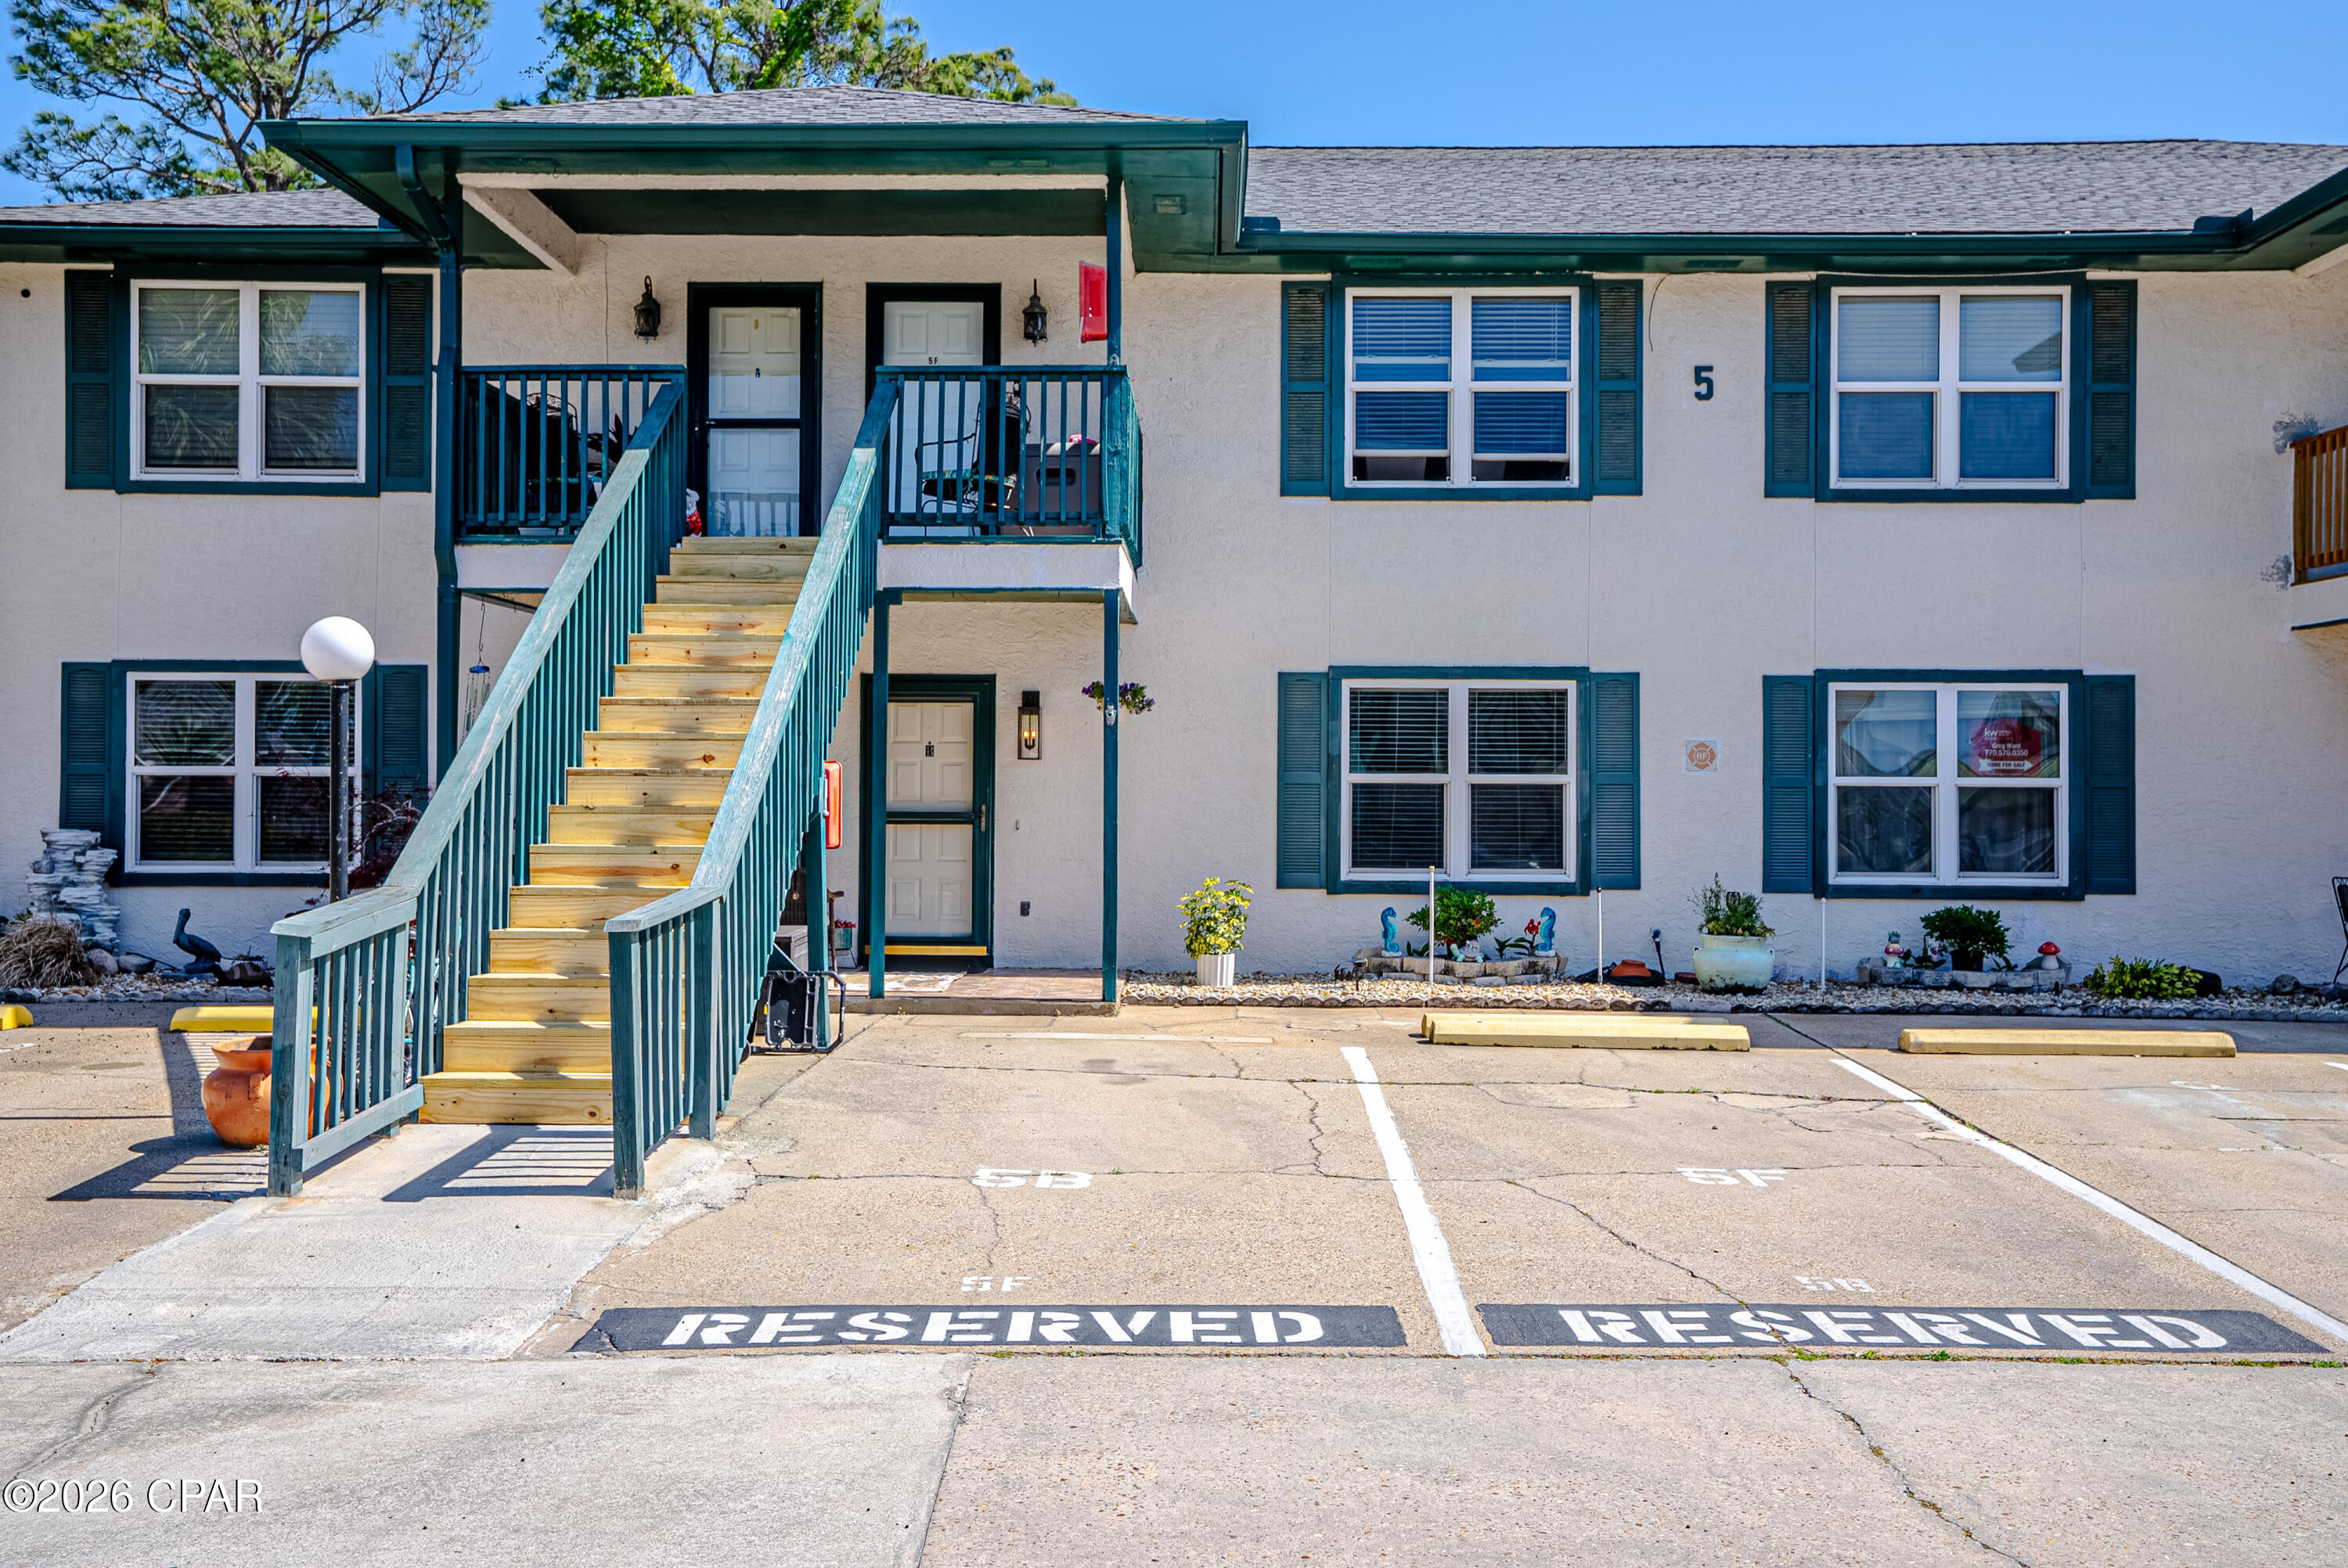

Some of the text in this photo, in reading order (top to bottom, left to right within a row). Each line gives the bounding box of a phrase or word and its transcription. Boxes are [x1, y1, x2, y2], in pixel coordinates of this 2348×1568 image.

[1694, 365, 1713, 401] 5
[1984, 728, 1998, 736] kw
[1696, 752, 1708, 761] RF
[971, 1166, 1093, 1189] 5B
[1675, 1167, 1788, 1188] 5F
[960, 1276, 1032, 1292] 5F
[661, 1311, 1324, 1346] RESERVED
[1558, 1310, 2227, 1348] RESERVED
